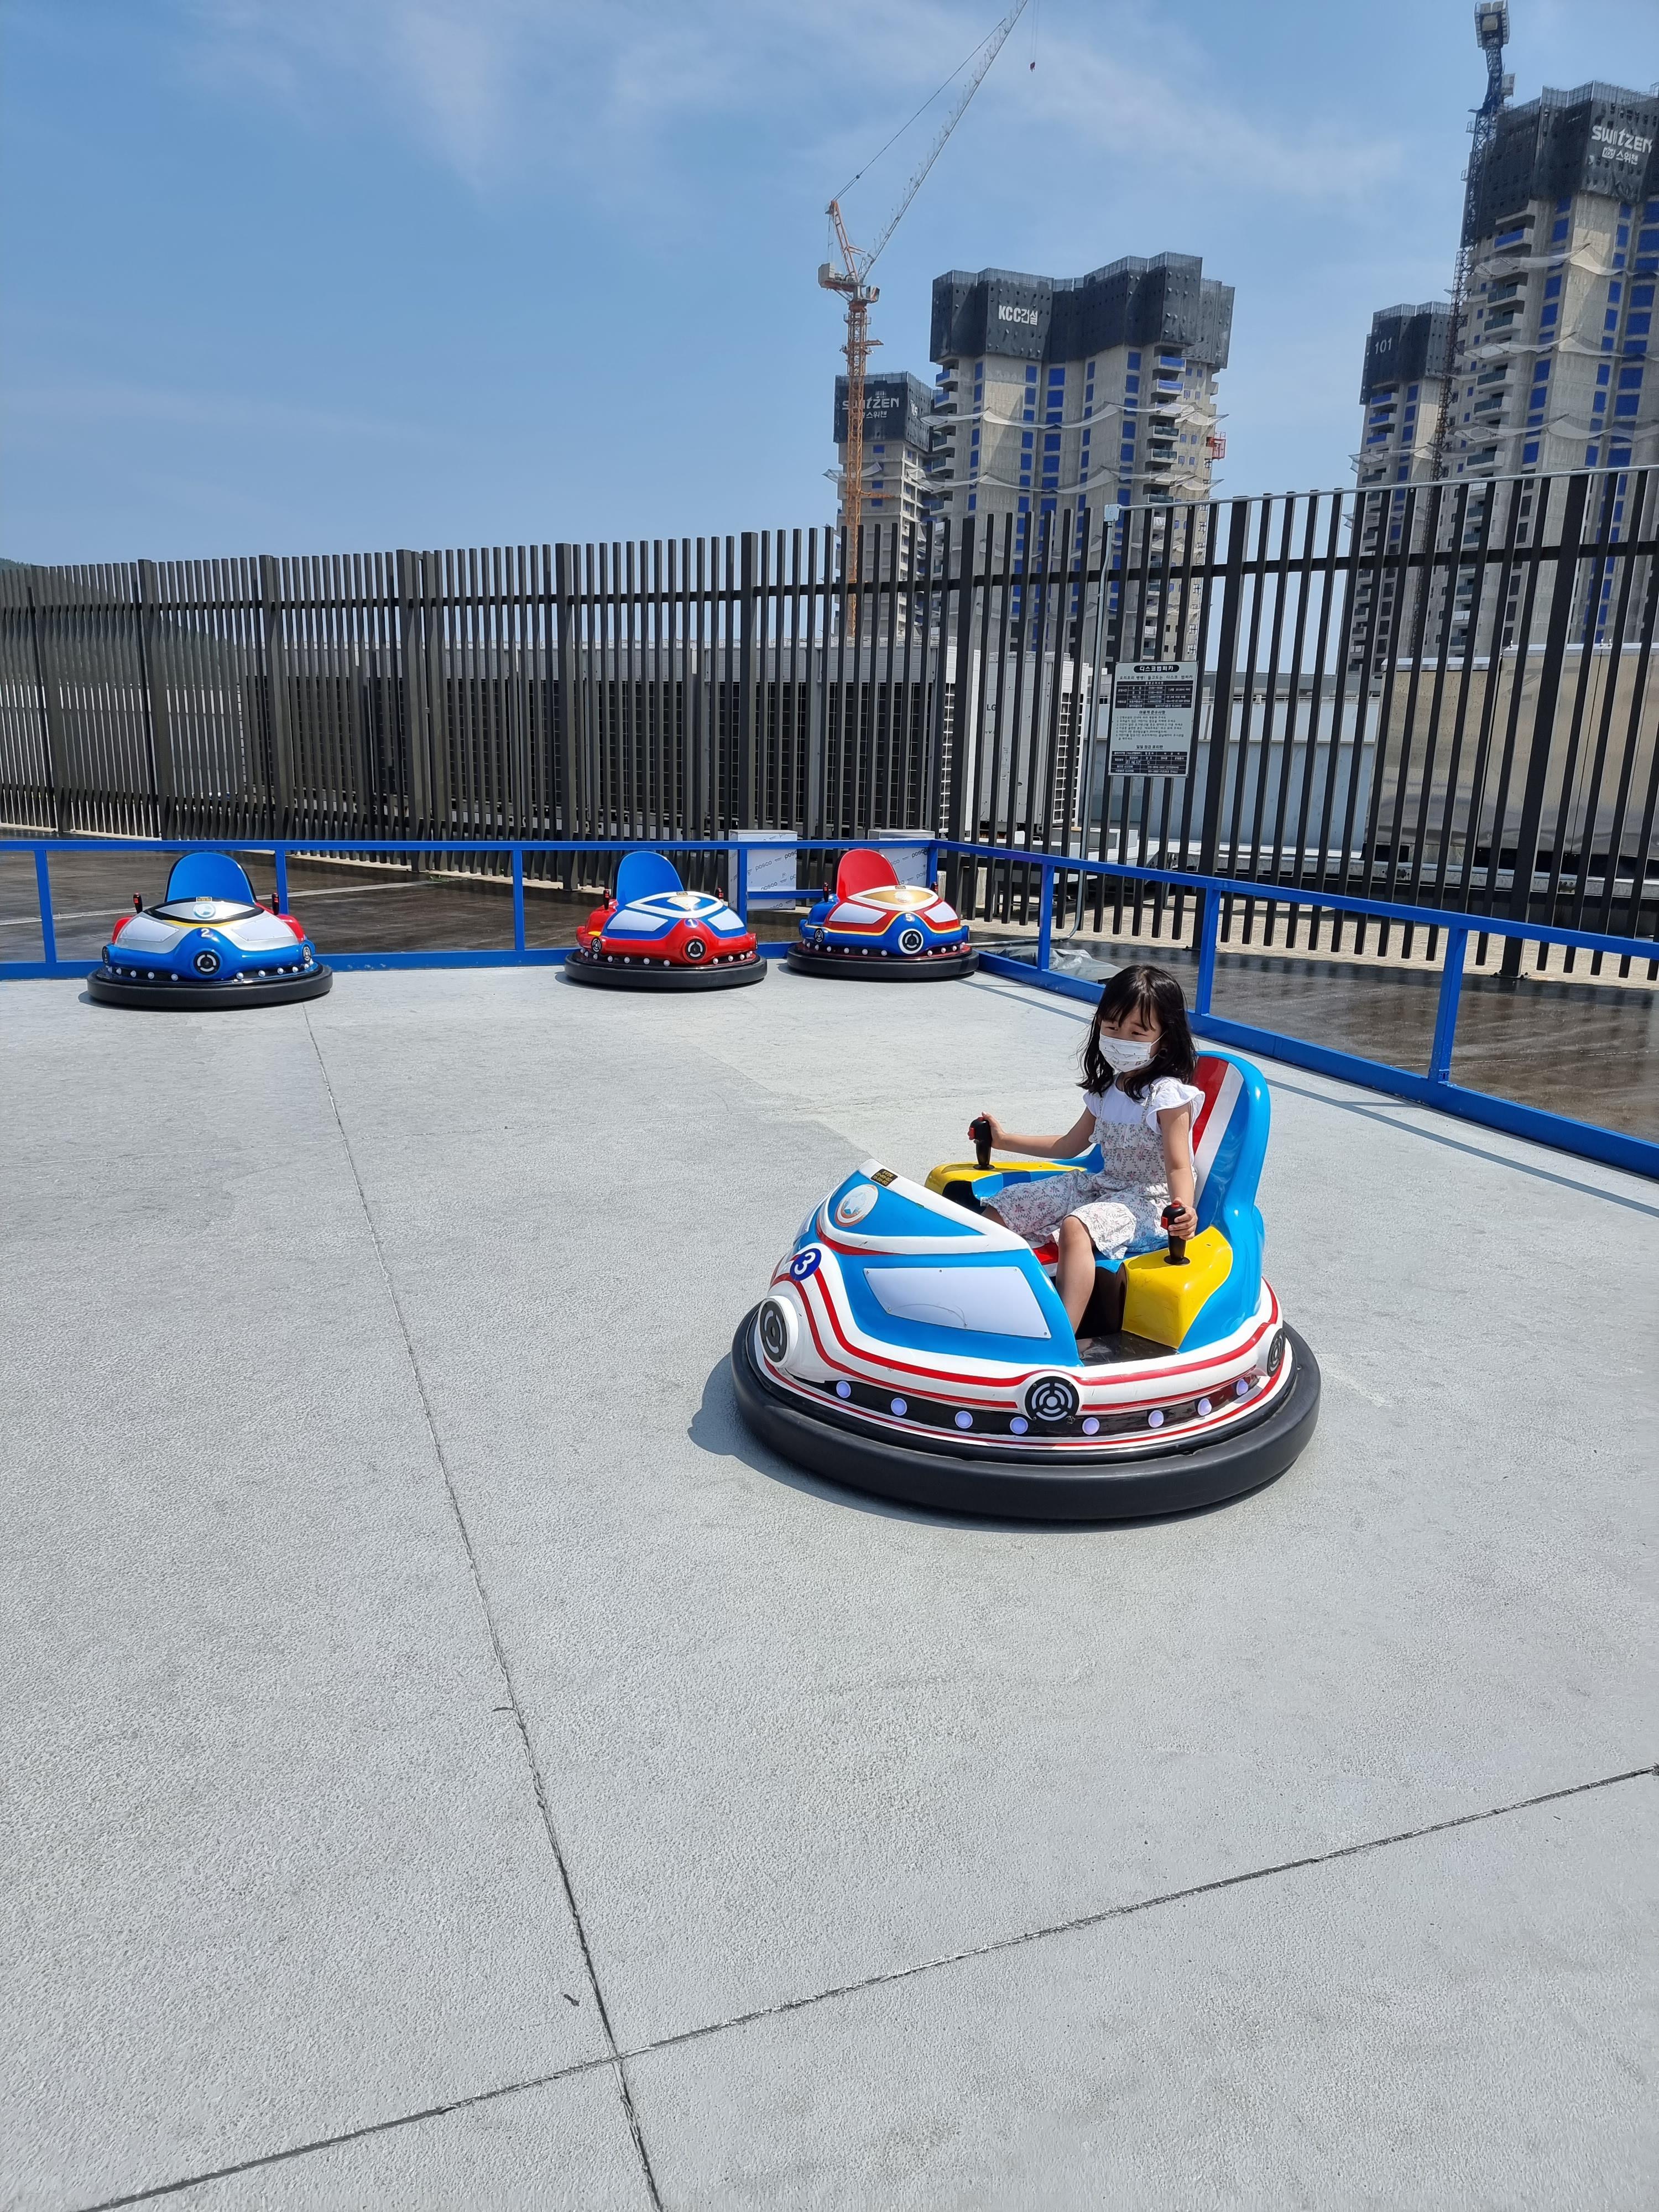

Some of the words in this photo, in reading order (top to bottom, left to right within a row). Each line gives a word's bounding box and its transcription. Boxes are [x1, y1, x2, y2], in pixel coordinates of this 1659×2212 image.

[998, 305, 1038, 326] KCC건설
[1375, 337, 1392, 354] 101
[755, 860, 773, 872] posco
[687, 919, 696, 927] 1
[905, 913, 914, 922] 5
[201, 928, 212, 937] 2
[794, 1251, 816, 1275] 3
